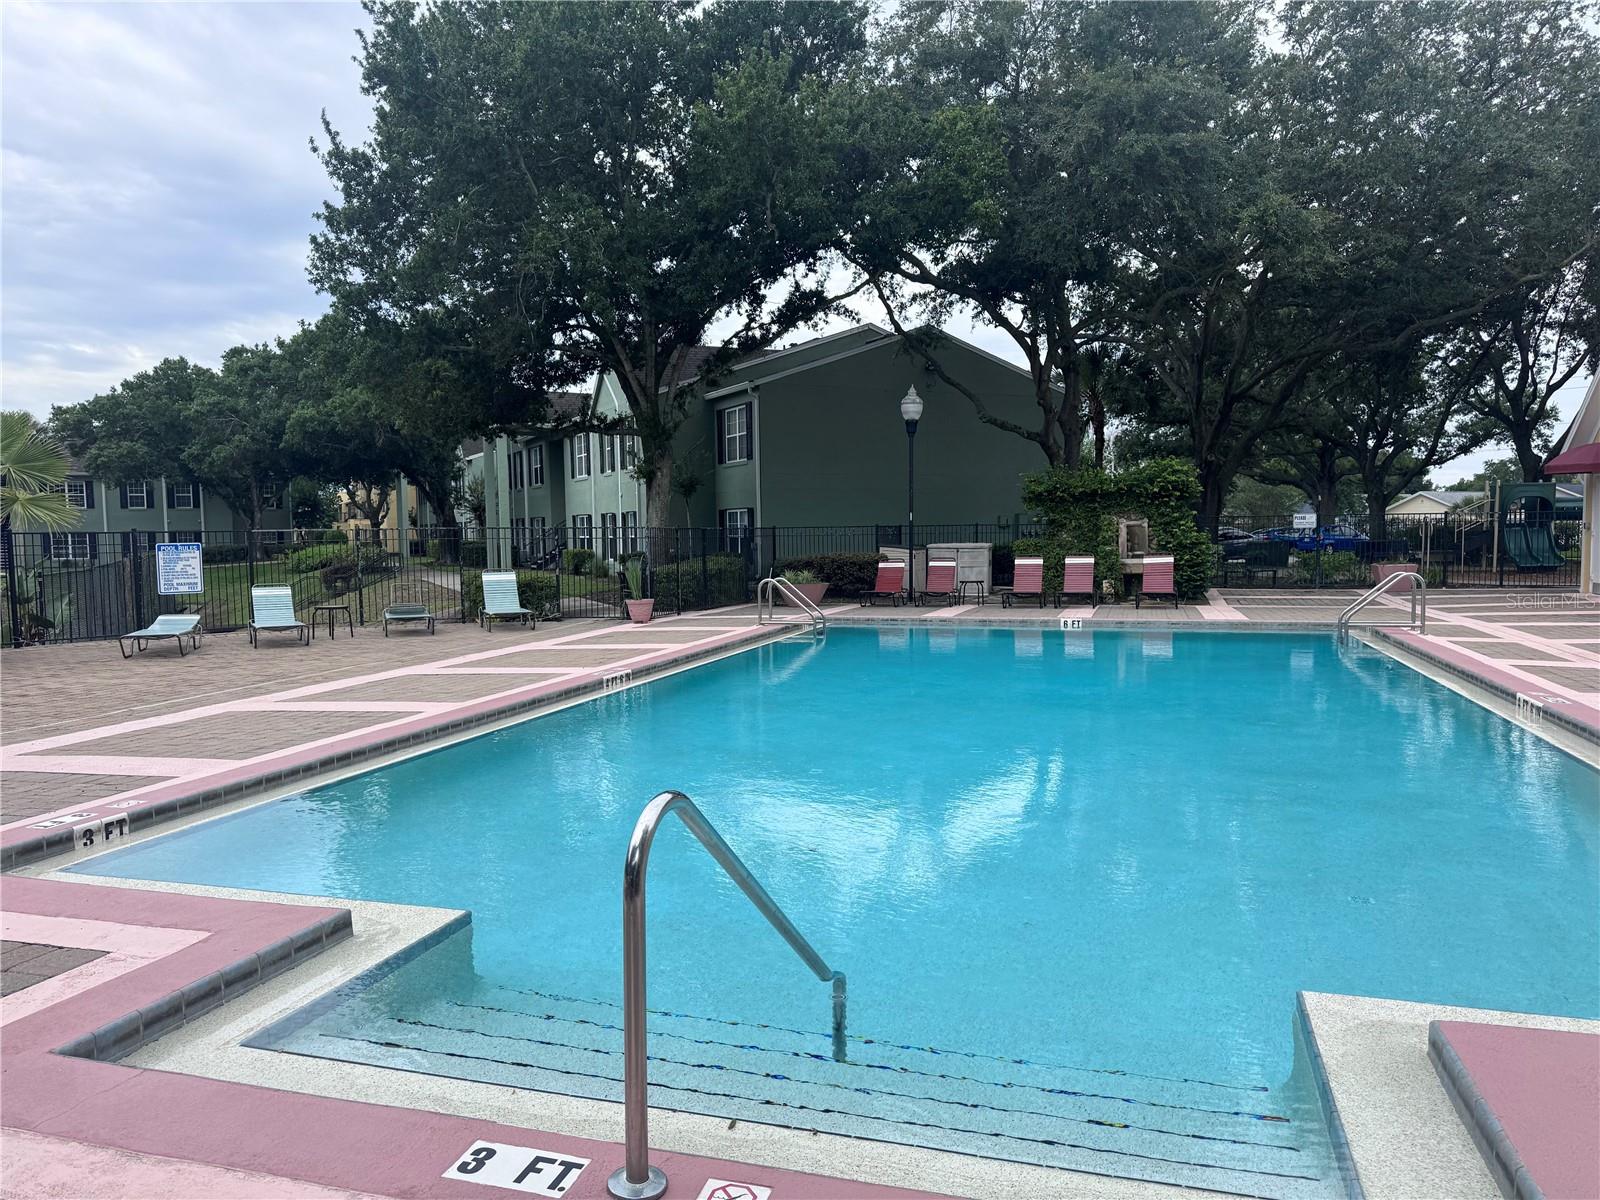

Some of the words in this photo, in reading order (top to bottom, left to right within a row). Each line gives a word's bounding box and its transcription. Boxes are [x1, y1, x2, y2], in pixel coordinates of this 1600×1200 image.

[1063, 620, 1069, 629] 6
[1071, 620, 1081, 629] FT
[82, 828, 95, 847] 3
[104, 818, 127, 841] FT
[456, 1147, 497, 1175] 3
[513, 1155, 586, 1192] FT.
